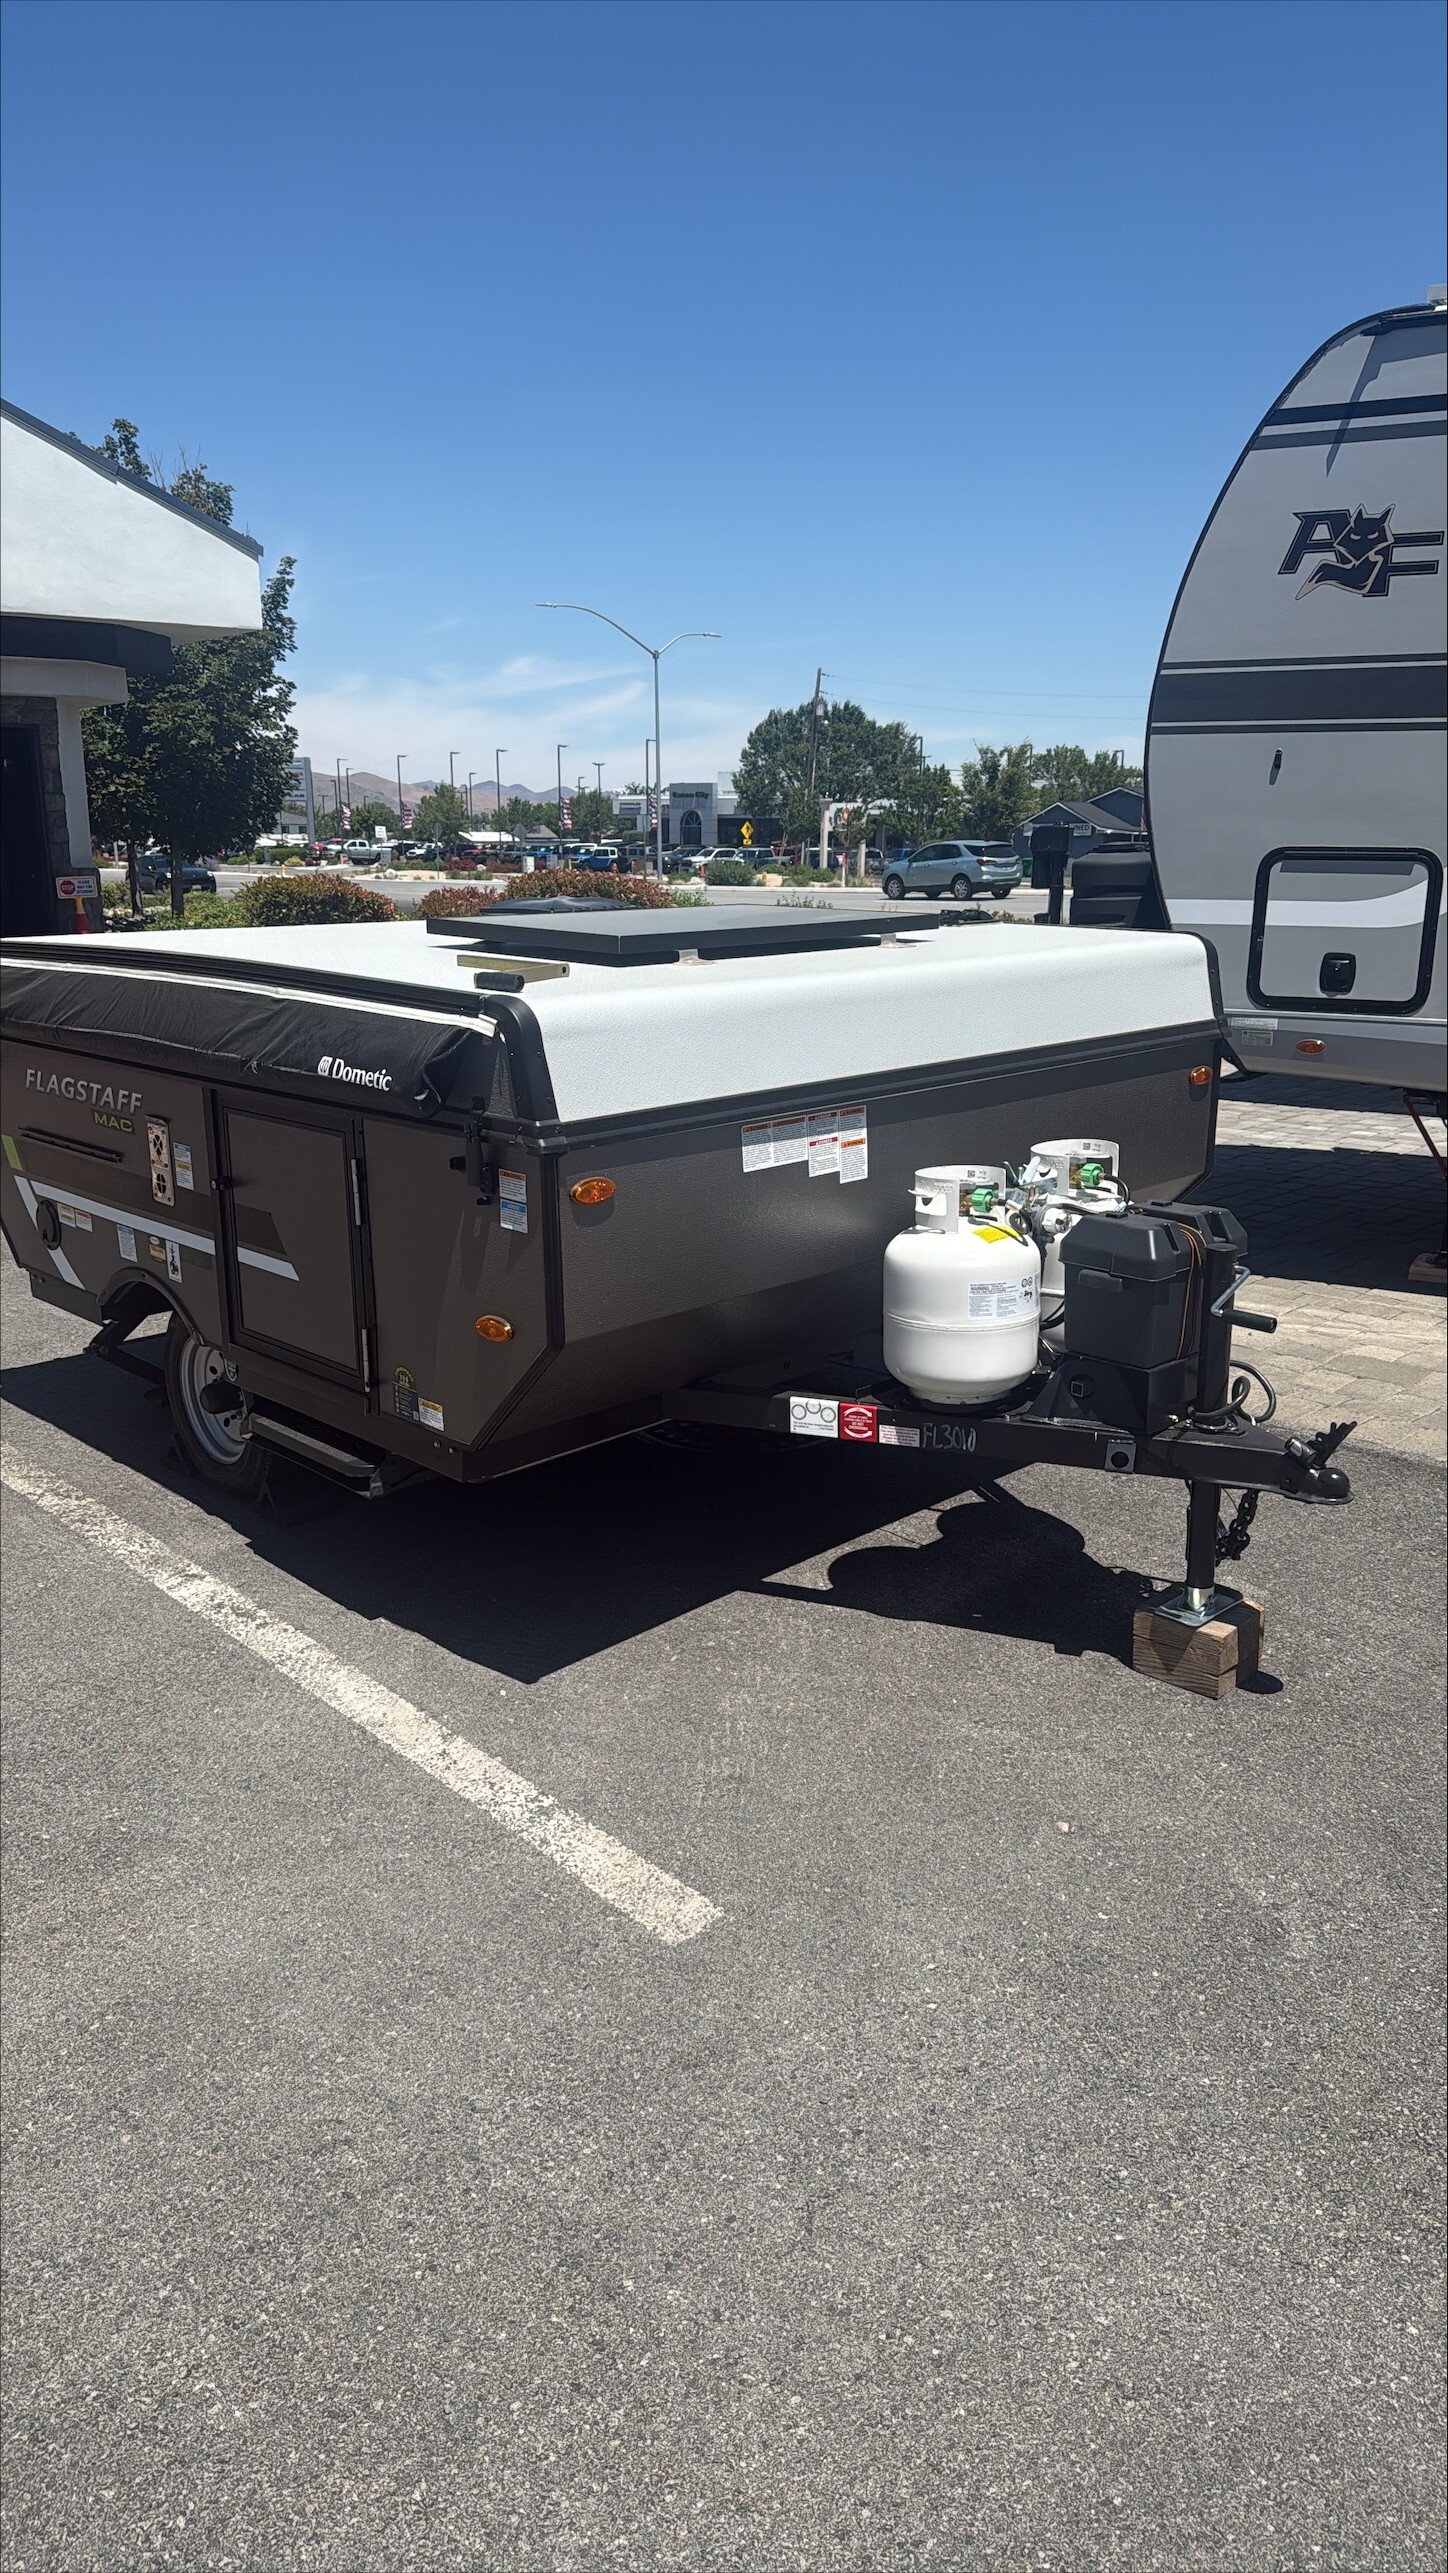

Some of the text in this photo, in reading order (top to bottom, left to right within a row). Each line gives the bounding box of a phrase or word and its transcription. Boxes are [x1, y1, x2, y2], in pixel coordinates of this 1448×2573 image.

[25, 1068, 142, 1114] FLAGSTAFF
[332, 1058, 392, 1091] Dometic
[94, 1111, 133, 1133] MAC
